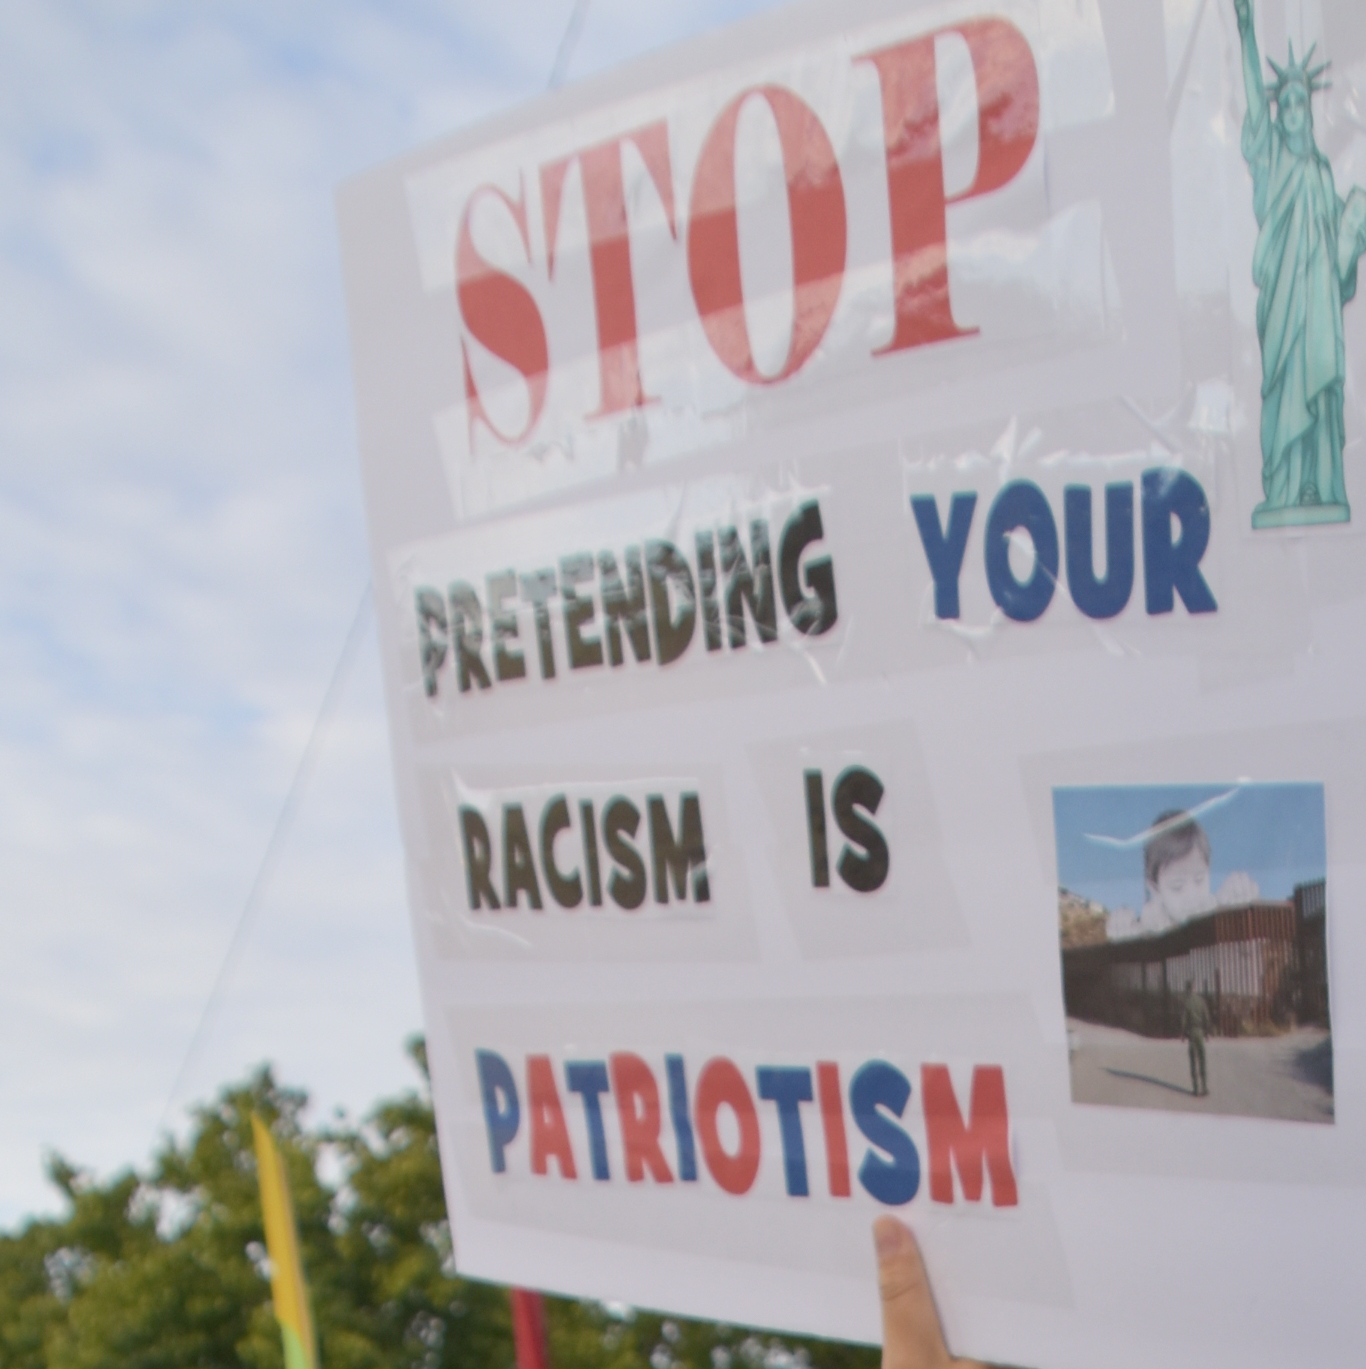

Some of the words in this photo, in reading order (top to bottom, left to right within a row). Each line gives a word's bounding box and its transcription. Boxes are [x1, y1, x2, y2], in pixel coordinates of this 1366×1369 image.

[455, 12, 1042, 450] STOP
[412, 498, 838, 698] PRETENDING
[910, 467, 1218, 623] YOUR
[458, 792, 711, 911] RACISM
[804, 766, 890, 893] IS
[474, 1049, 1018, 1207] PATRIOTISM
